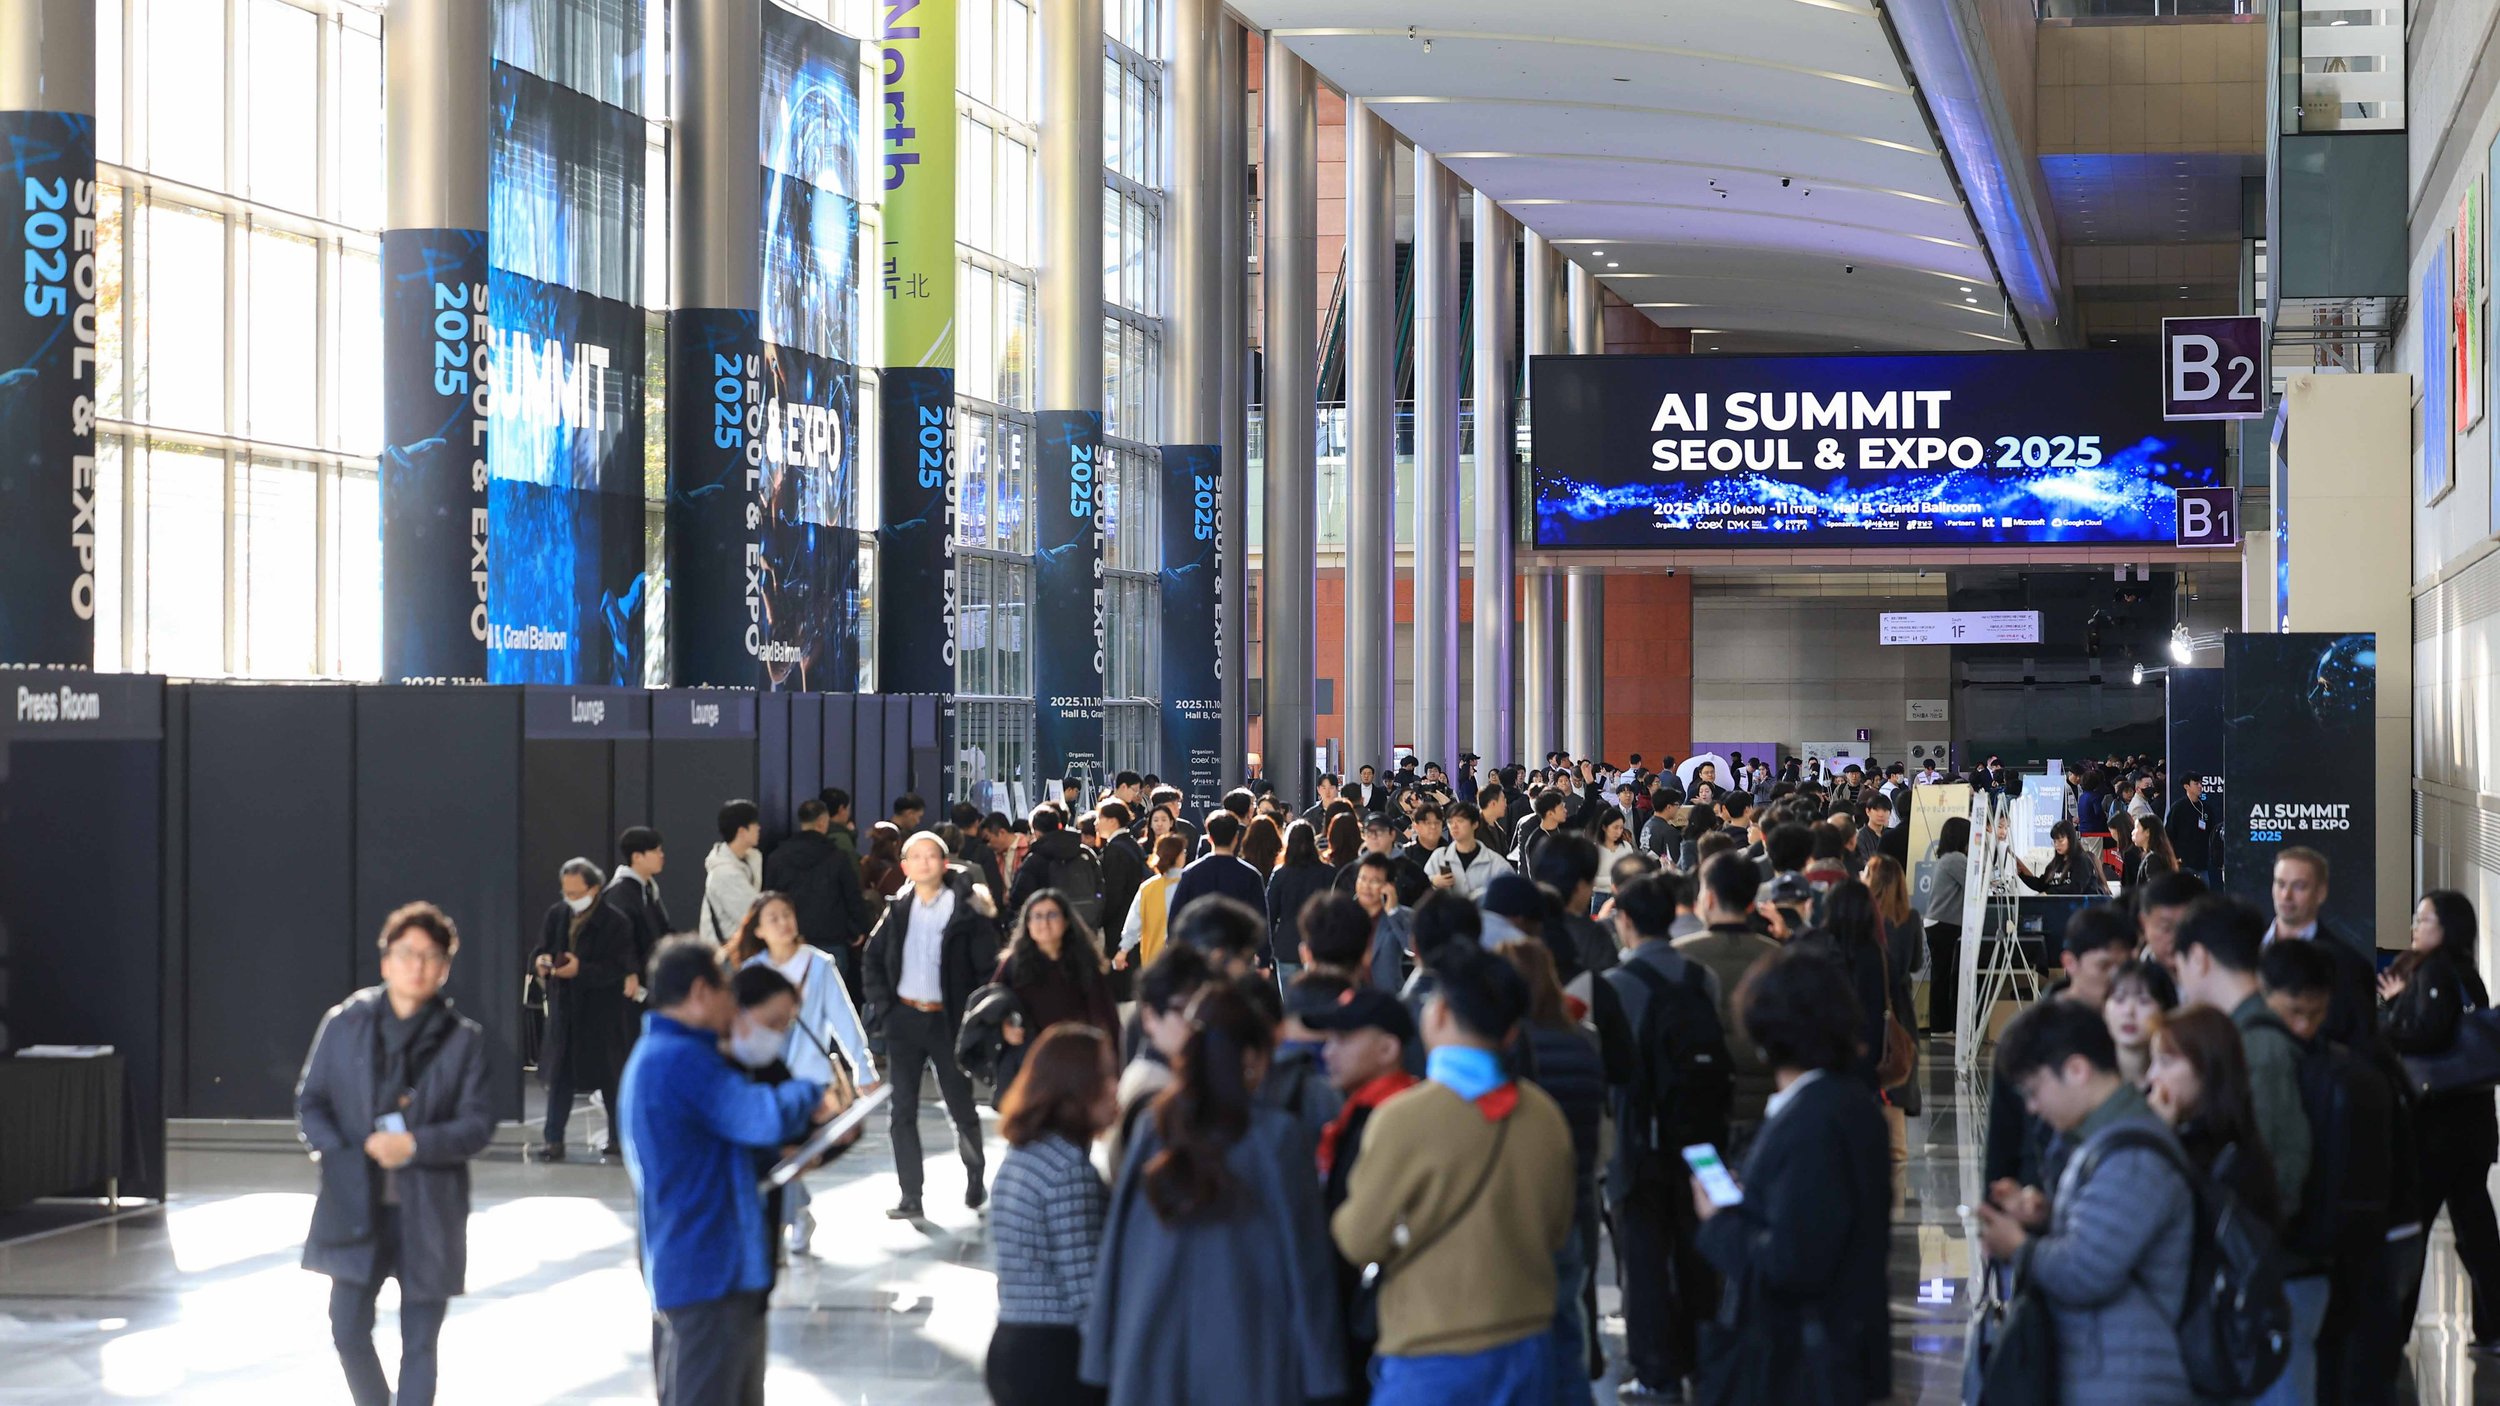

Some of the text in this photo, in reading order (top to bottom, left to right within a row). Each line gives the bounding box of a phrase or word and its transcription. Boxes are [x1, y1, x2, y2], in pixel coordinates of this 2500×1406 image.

[883, 0, 920, 190] North
[24, 176, 68, 318] 2025
[905, 273, 930, 299] 北
[434, 281, 469, 396] 2025
[488, 324, 610, 431] SUMMIT
[2172, 334, 2255, 401] B2
[71, 177, 96, 621] SEOUL & EXPO
[714, 353, 743, 449] 2025
[1650, 390, 1952, 431] AI SUMMIT
[766, 397, 842, 472] & EXPO
[919, 405, 943, 489] 2025
[471, 282, 489, 642] SEOUL & EXPO
[944, 405, 955, 525] SEOUL
[1652, 435, 2102, 471] SEOUL & EXPO 2025
[1070, 444, 1092, 518] 2025
[1094, 444, 1104, 550] SEOUL
[745, 353, 760, 656] SEOUL & EXPO
[1194, 474, 1213, 541] 2025
[1834, 502, 1859, 514] Hall
[1862, 502, 1875, 515] B,
[1878, 502, 1919, 514] Grand
[1921, 501, 1982, 513] Ballroom
[2013, 518, 2046, 526] Microsoft
[2062, 519, 2084, 527] Google
[2183, 498, 2229, 538] B1
[1695, 519, 1723, 530] coex
[942, 569, 955, 667] EXPO
[1093, 588, 1103, 674] EXPO
[1951, 625, 1966, 638] 1F
[759, 640, 774, 661] rand
[17, 685, 99, 721] Press Room
[571, 695, 605, 725] Lounge
[691, 700, 719, 726] Lounge
[1050, 697, 1101, 707] 2025.11.10
[1061, 709, 1079, 718] Hall
[1081, 710, 1089, 719] B,
[1175, 700, 1221, 709] 2025.11.10
[1185, 711, 1201, 719] Hall
[1203, 711, 1210, 720] B,
[1069, 751, 1094, 759] Organizers
[1191, 756, 1209, 764] coex
[2202, 776, 2225, 786] SUM
[1191, 800, 1199, 808] kt
[2250, 804, 2350, 818] AI SUMMIT
[2250, 819, 2350, 830] SEOUL & EXPO
[2250, 831, 2282, 842] 2025
